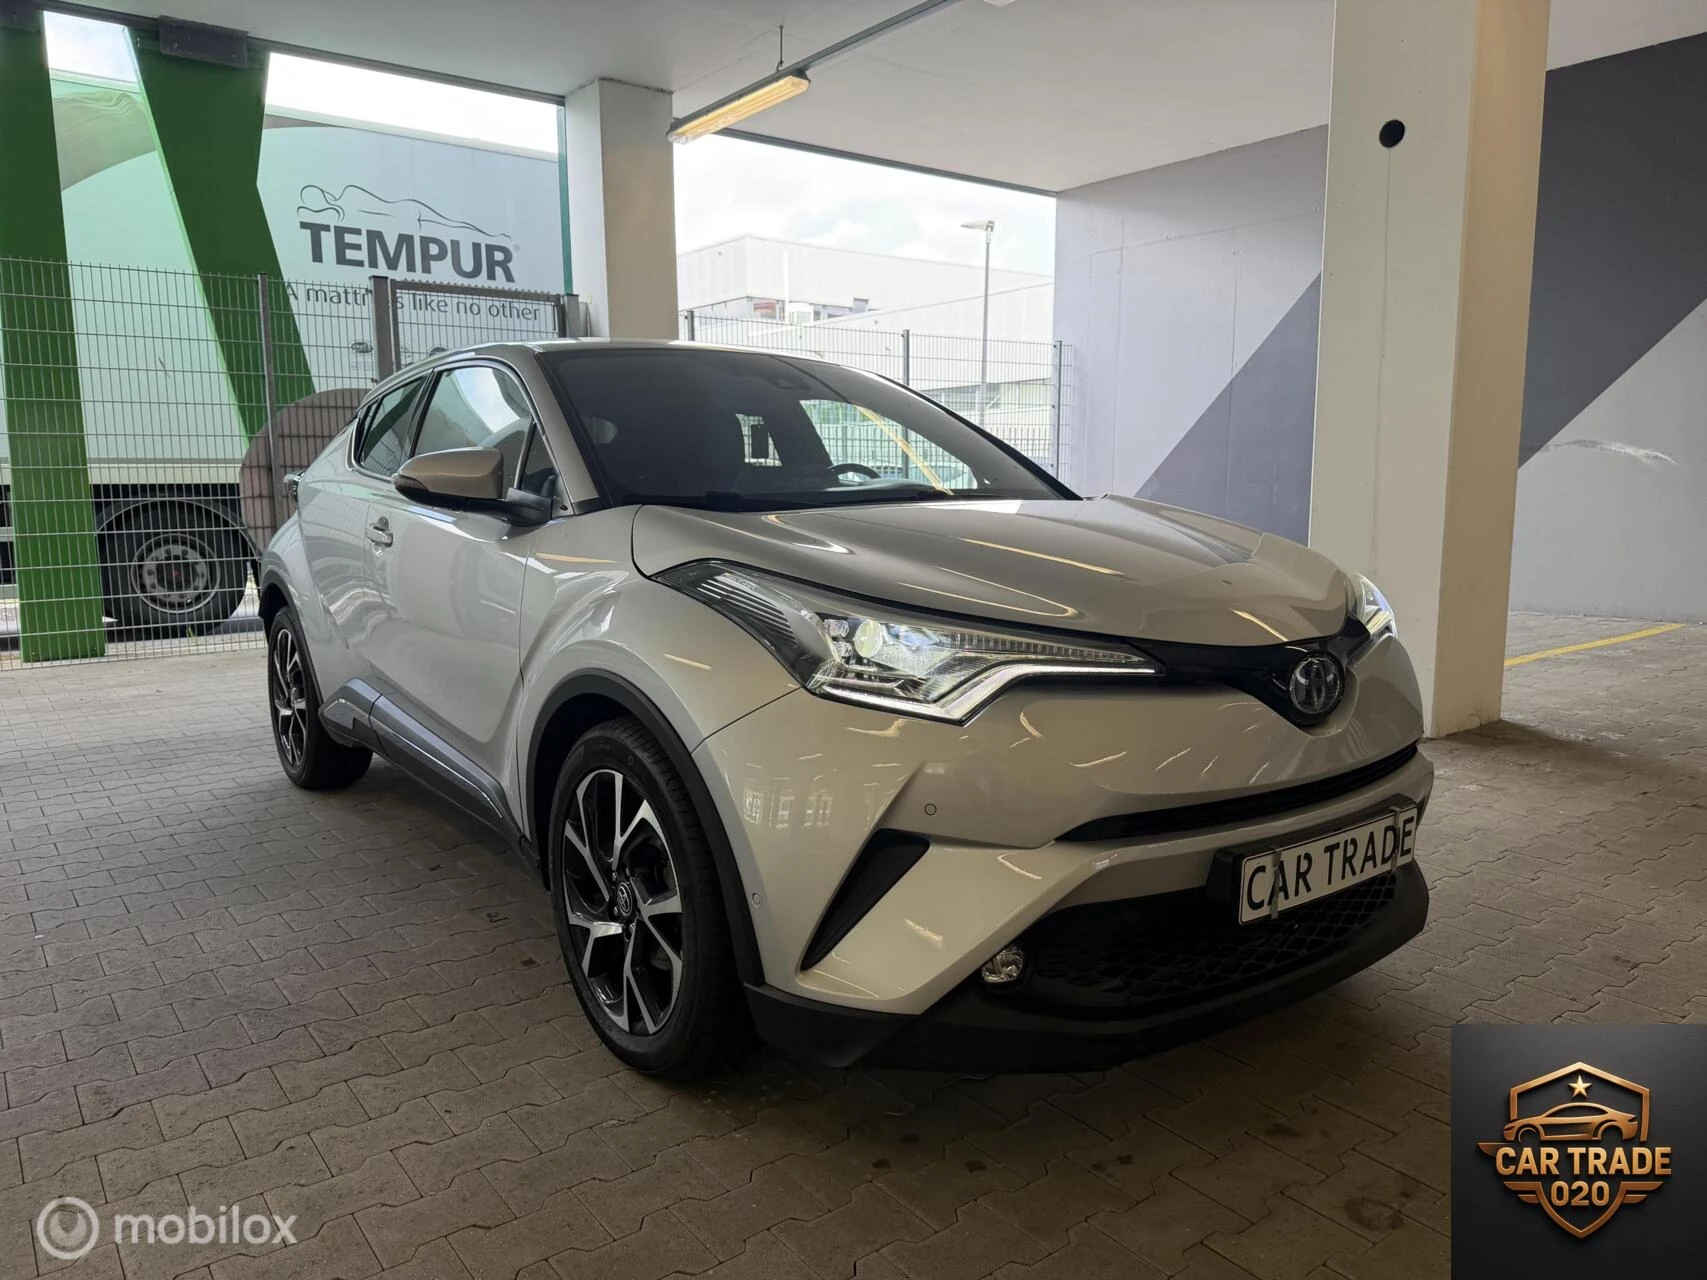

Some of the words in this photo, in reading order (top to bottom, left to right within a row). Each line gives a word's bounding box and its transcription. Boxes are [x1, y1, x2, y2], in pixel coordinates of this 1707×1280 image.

[299, 221, 515, 283] TEMPUR
[306, 287, 405, 310] mattrs
[412, 292, 449, 313] like
[456, 300, 481, 316] no
[488, 301, 540, 320] other
[1247, 852, 1313, 911] CAR
[1324, 817, 1414, 886] TRADE
